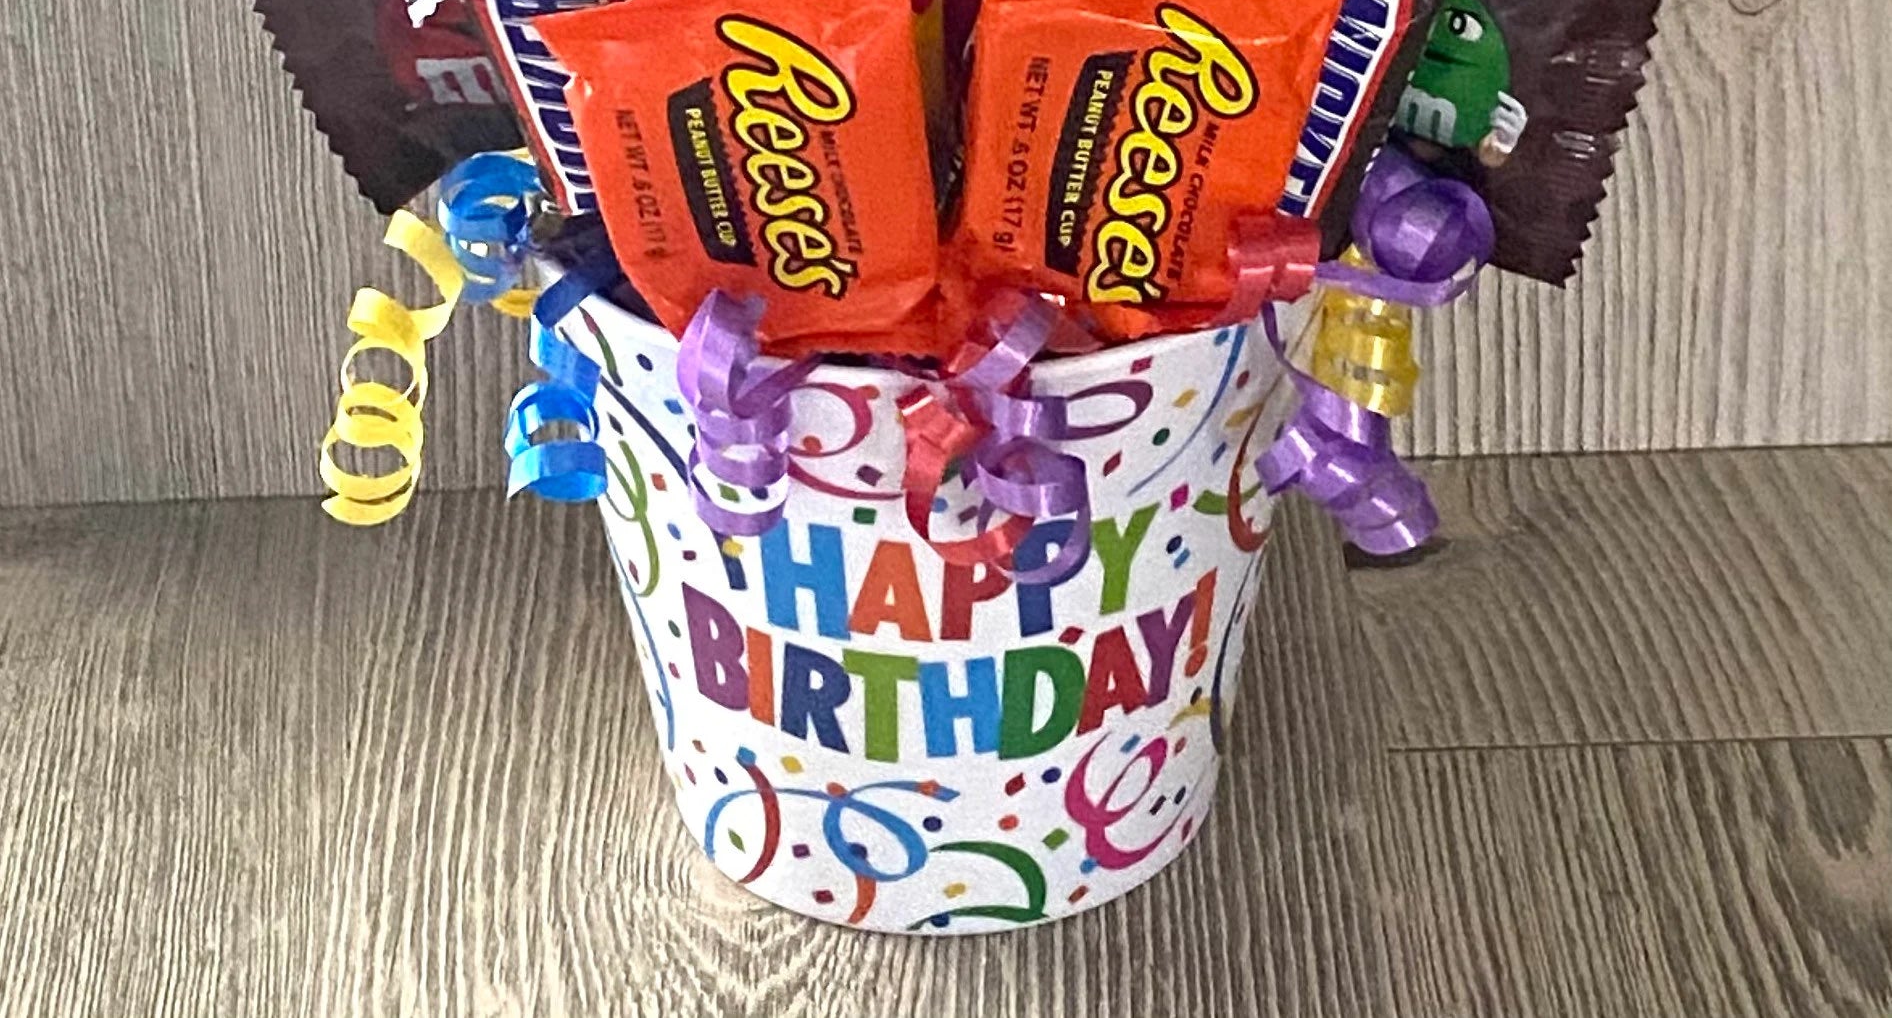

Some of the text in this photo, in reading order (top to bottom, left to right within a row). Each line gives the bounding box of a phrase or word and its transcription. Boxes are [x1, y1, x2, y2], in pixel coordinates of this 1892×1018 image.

[614, 107, 643, 143] NET
[1016, 99, 1041, 134] WT
[625, 143, 650, 173] WT
[684, 105, 715, 166] PEANUT
[700, 167, 730, 220] BUTTER
[1004, 158, 1028, 196] OZ
[1058, 70, 1111, 248] PEANUT BUTTER CUP
[635, 192, 662, 219] OZ
[1167, 123, 1219, 281] MILK CHOCOLATE
[760, 503, 1159, 642] HAPPY
[682, 568, 1217, 762] BIRTHDAY!
